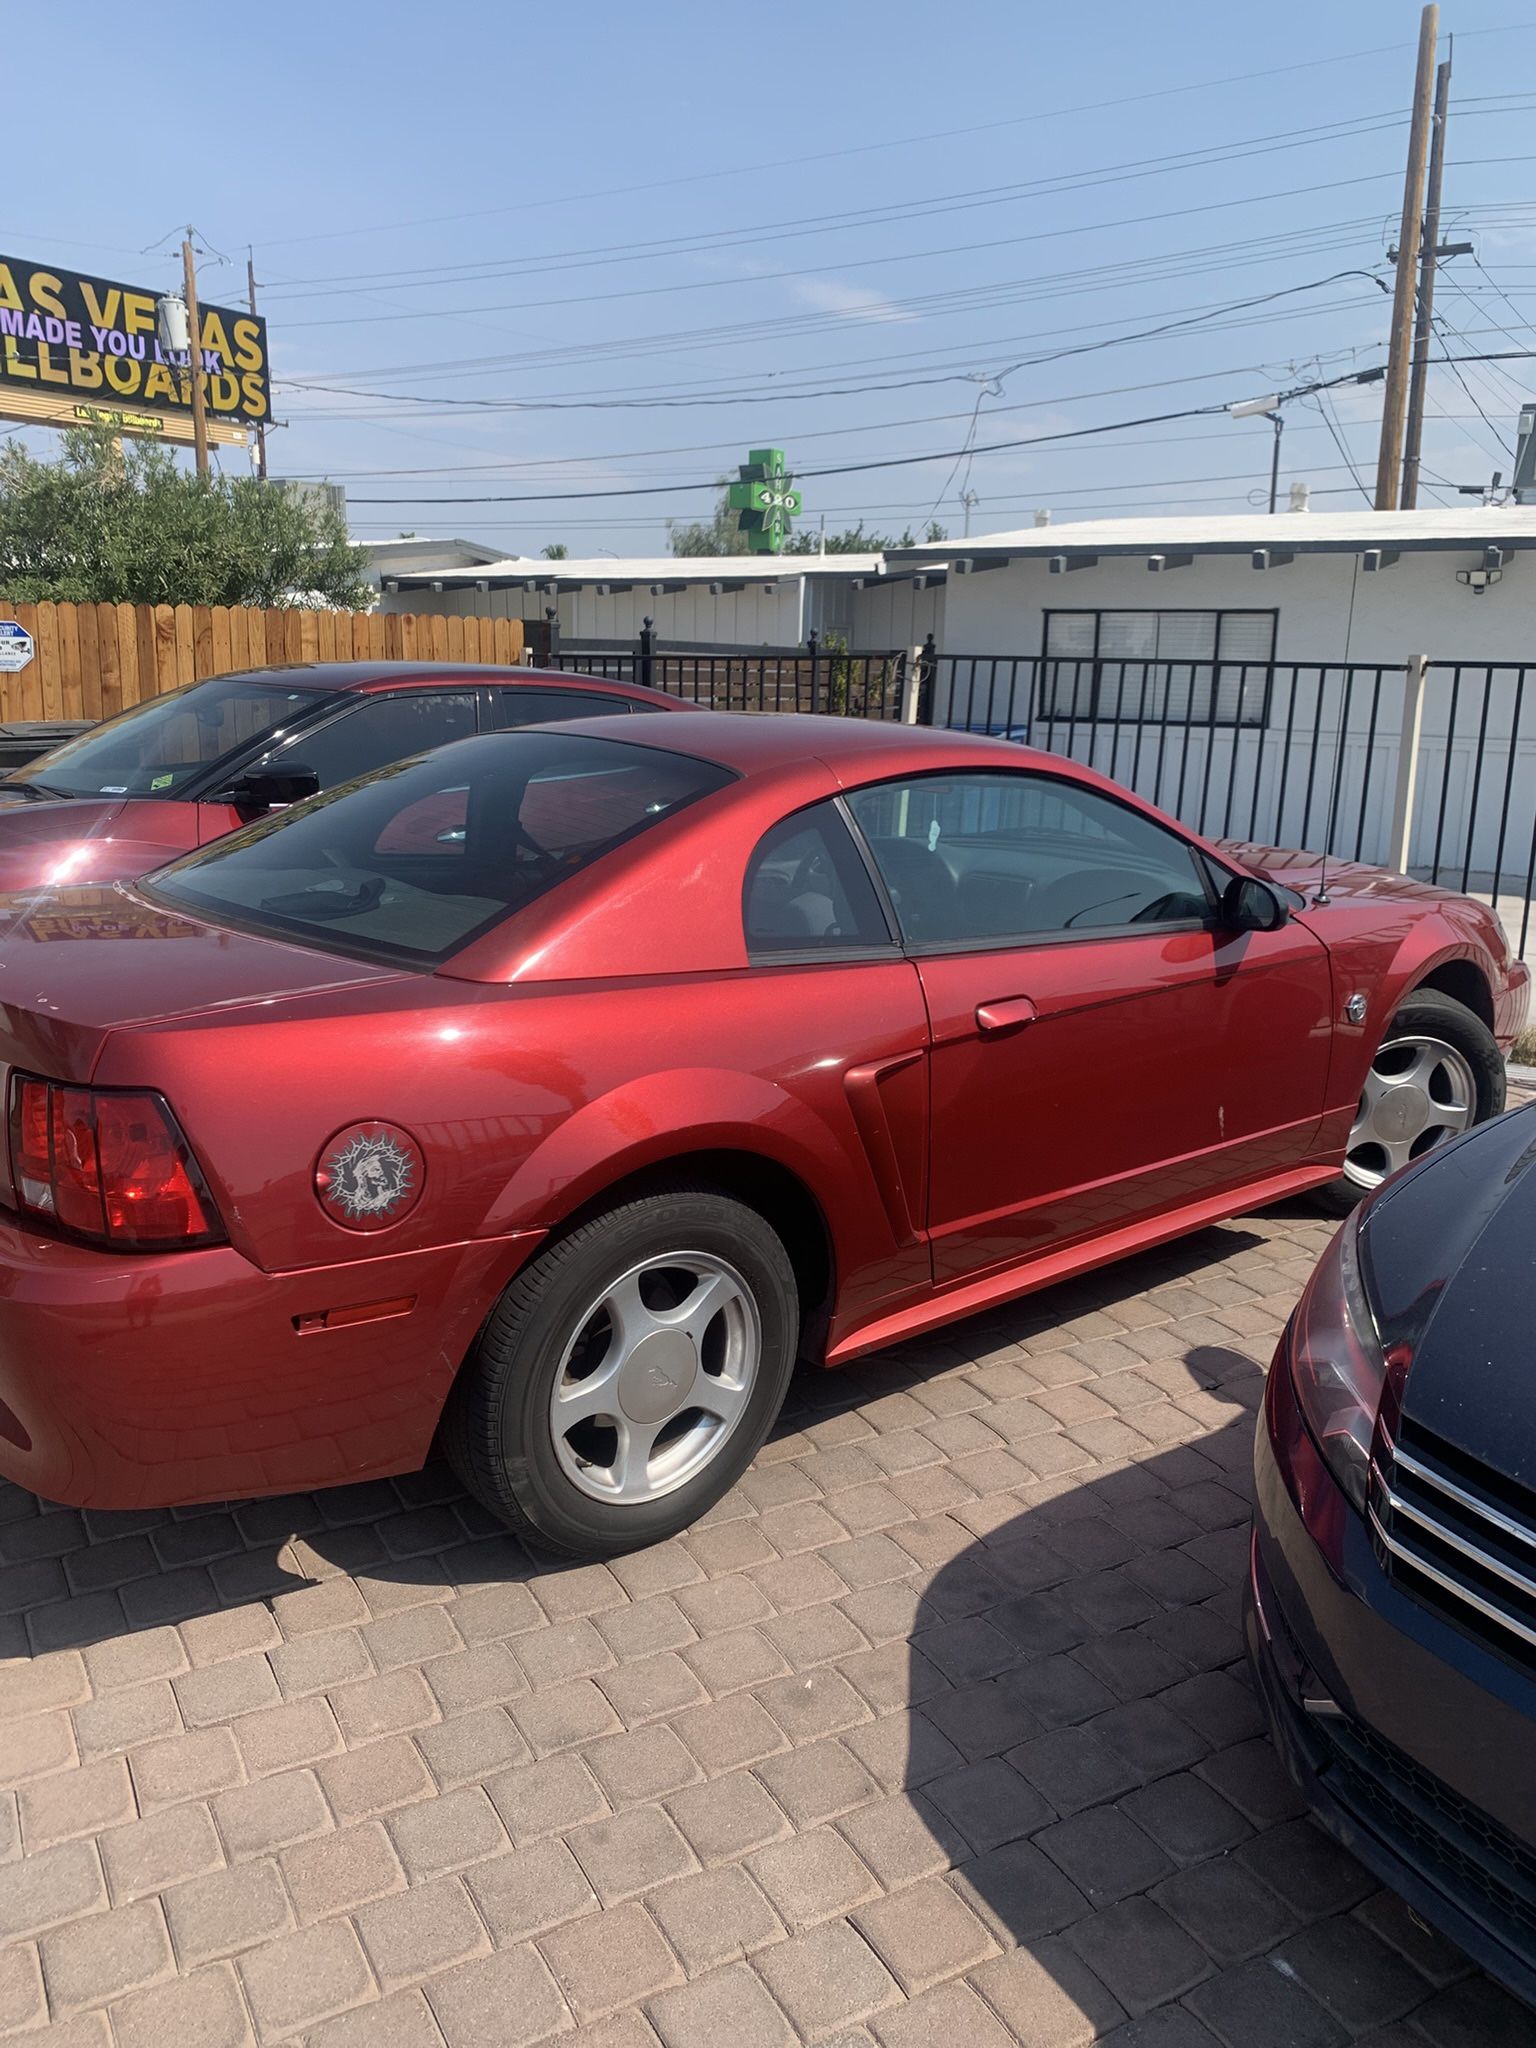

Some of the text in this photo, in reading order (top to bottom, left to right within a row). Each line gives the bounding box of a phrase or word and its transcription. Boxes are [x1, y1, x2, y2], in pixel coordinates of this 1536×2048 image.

[0, 307, 222, 376] MADE YOU LOK
[79, 281, 263, 372] VEAS
[0, 335, 267, 417] LLBOARDS
[760, 491, 795, 509] 420
